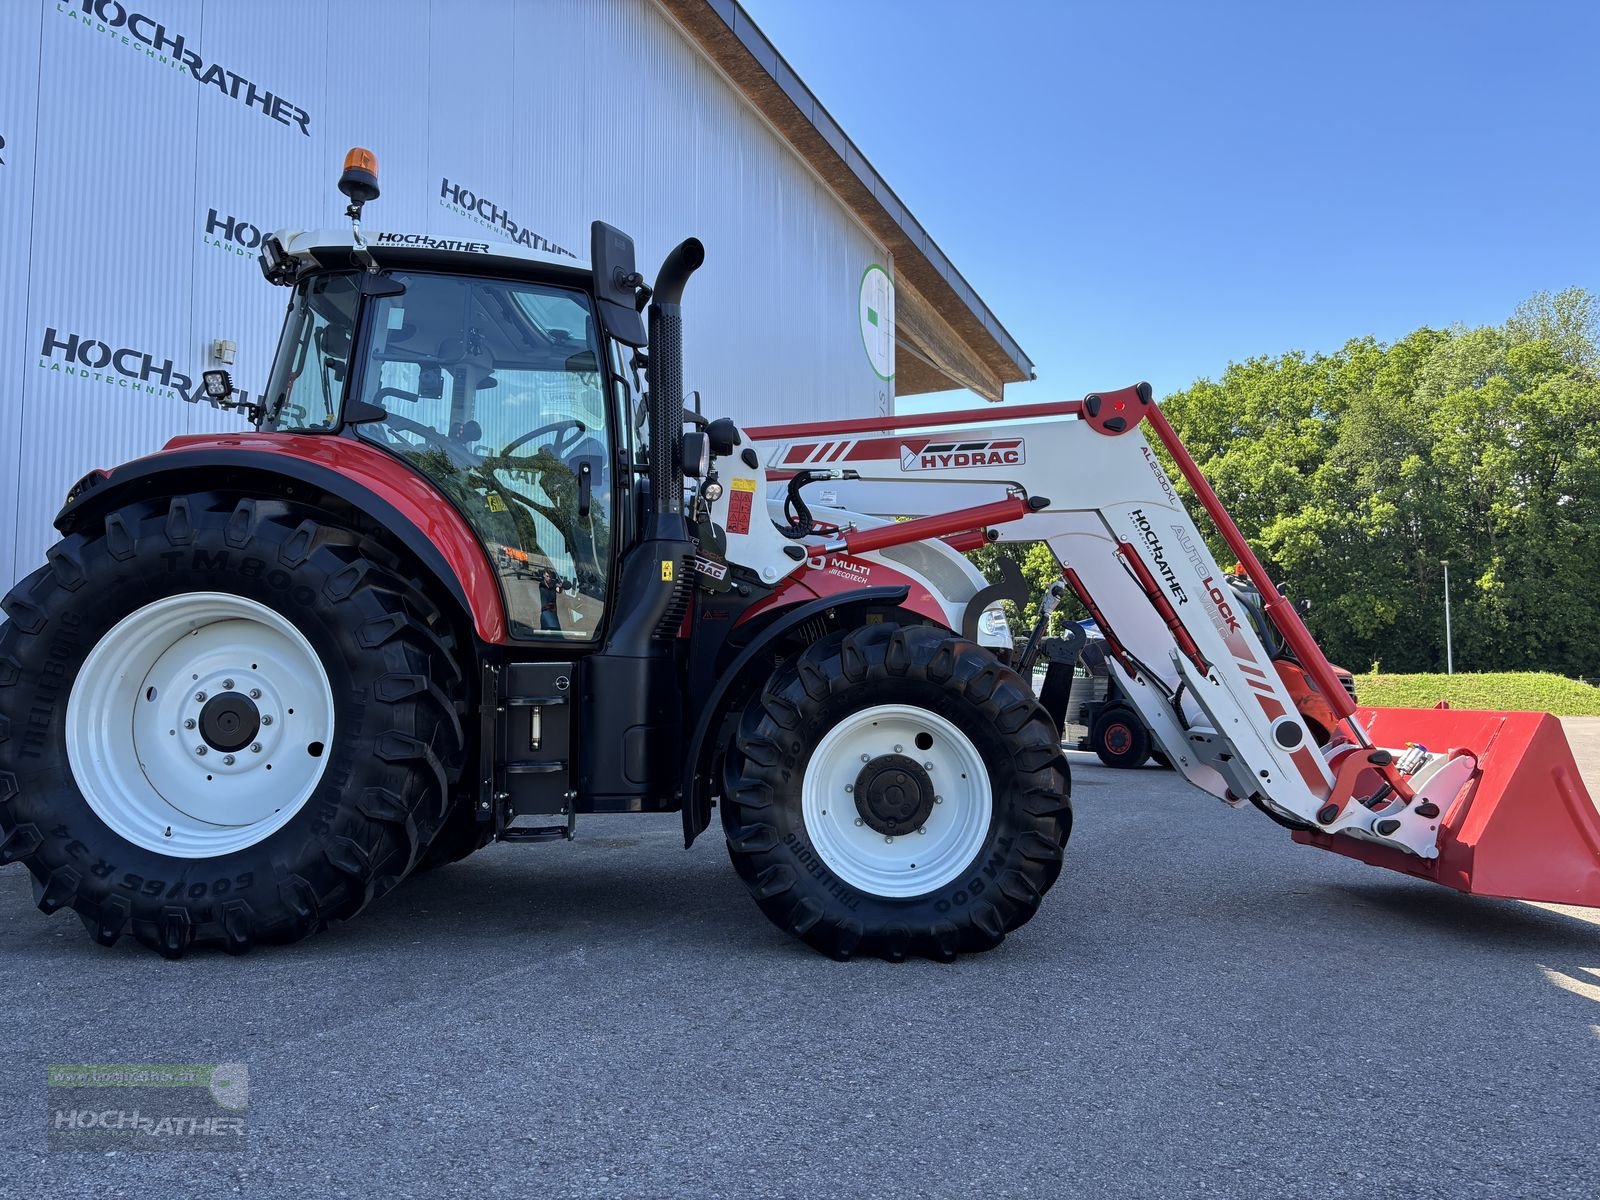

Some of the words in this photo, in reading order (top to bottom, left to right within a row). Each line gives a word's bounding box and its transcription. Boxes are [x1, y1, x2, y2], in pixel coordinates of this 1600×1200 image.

[56, 3, 187, 74] LANDTECHNIK
[377, 232, 490, 254] HOCHRATHER
[38, 359, 175, 400] LANDTECHNIK
[921, 450, 1019, 469] HYDRAC
[831, 558, 871, 576] MULTI
[1132, 508, 1189, 606] HOCHRATHER
